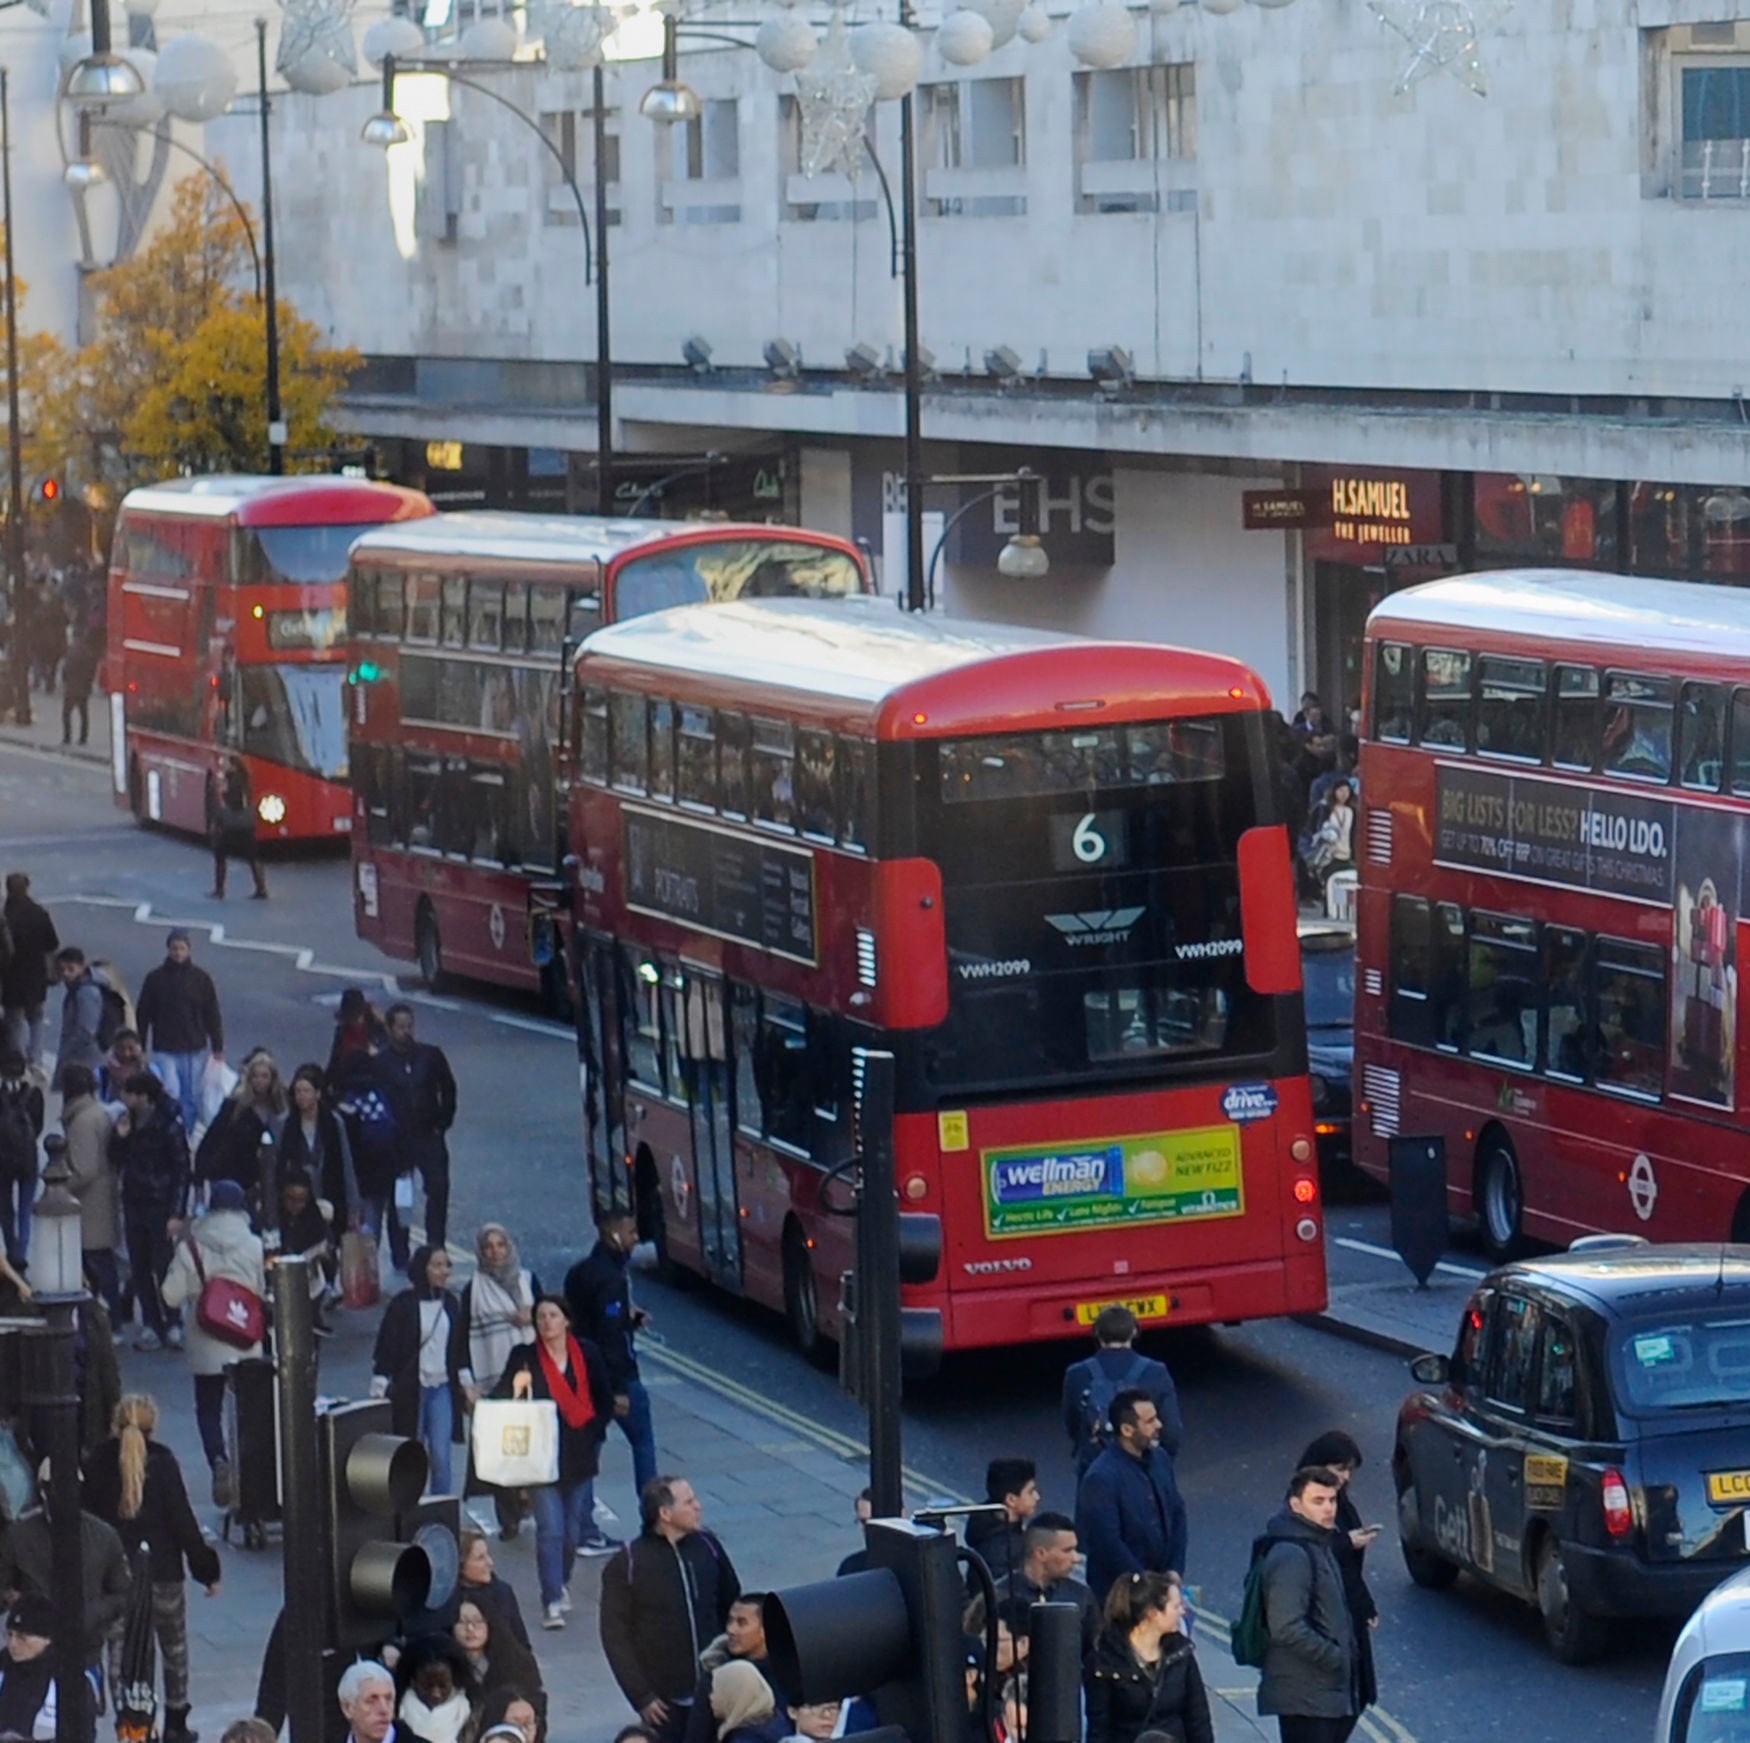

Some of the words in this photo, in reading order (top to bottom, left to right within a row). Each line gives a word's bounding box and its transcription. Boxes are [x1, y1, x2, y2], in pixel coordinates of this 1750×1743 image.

[1332, 479, 1411, 520] H.SAMUEL
[1334, 521, 1355, 539] THE
[1358, 524, 1411, 545] JEWELLER
[1442, 789, 1465, 821] BIG
[1467, 792, 1504, 828] LISTS
[1537, 804, 1579, 840] LESS?
[1580, 809, 1628, 851] HELLO
[1629, 817, 1668, 859] LDO.
[1073, 813, 1106, 862] 6
[1065, 929, 1131, 947] WRIGHT
[1174, 938, 1244, 960] VWH2099
[959, 959, 1031, 980] VWH2099
[1175, 1163, 1204, 1177] NEW
[1205, 1161, 1231, 1175] FIZZ
[1042, 1179, 1102, 1196] ENERGY
[963, 1257, 1033, 1276] VOLVO
